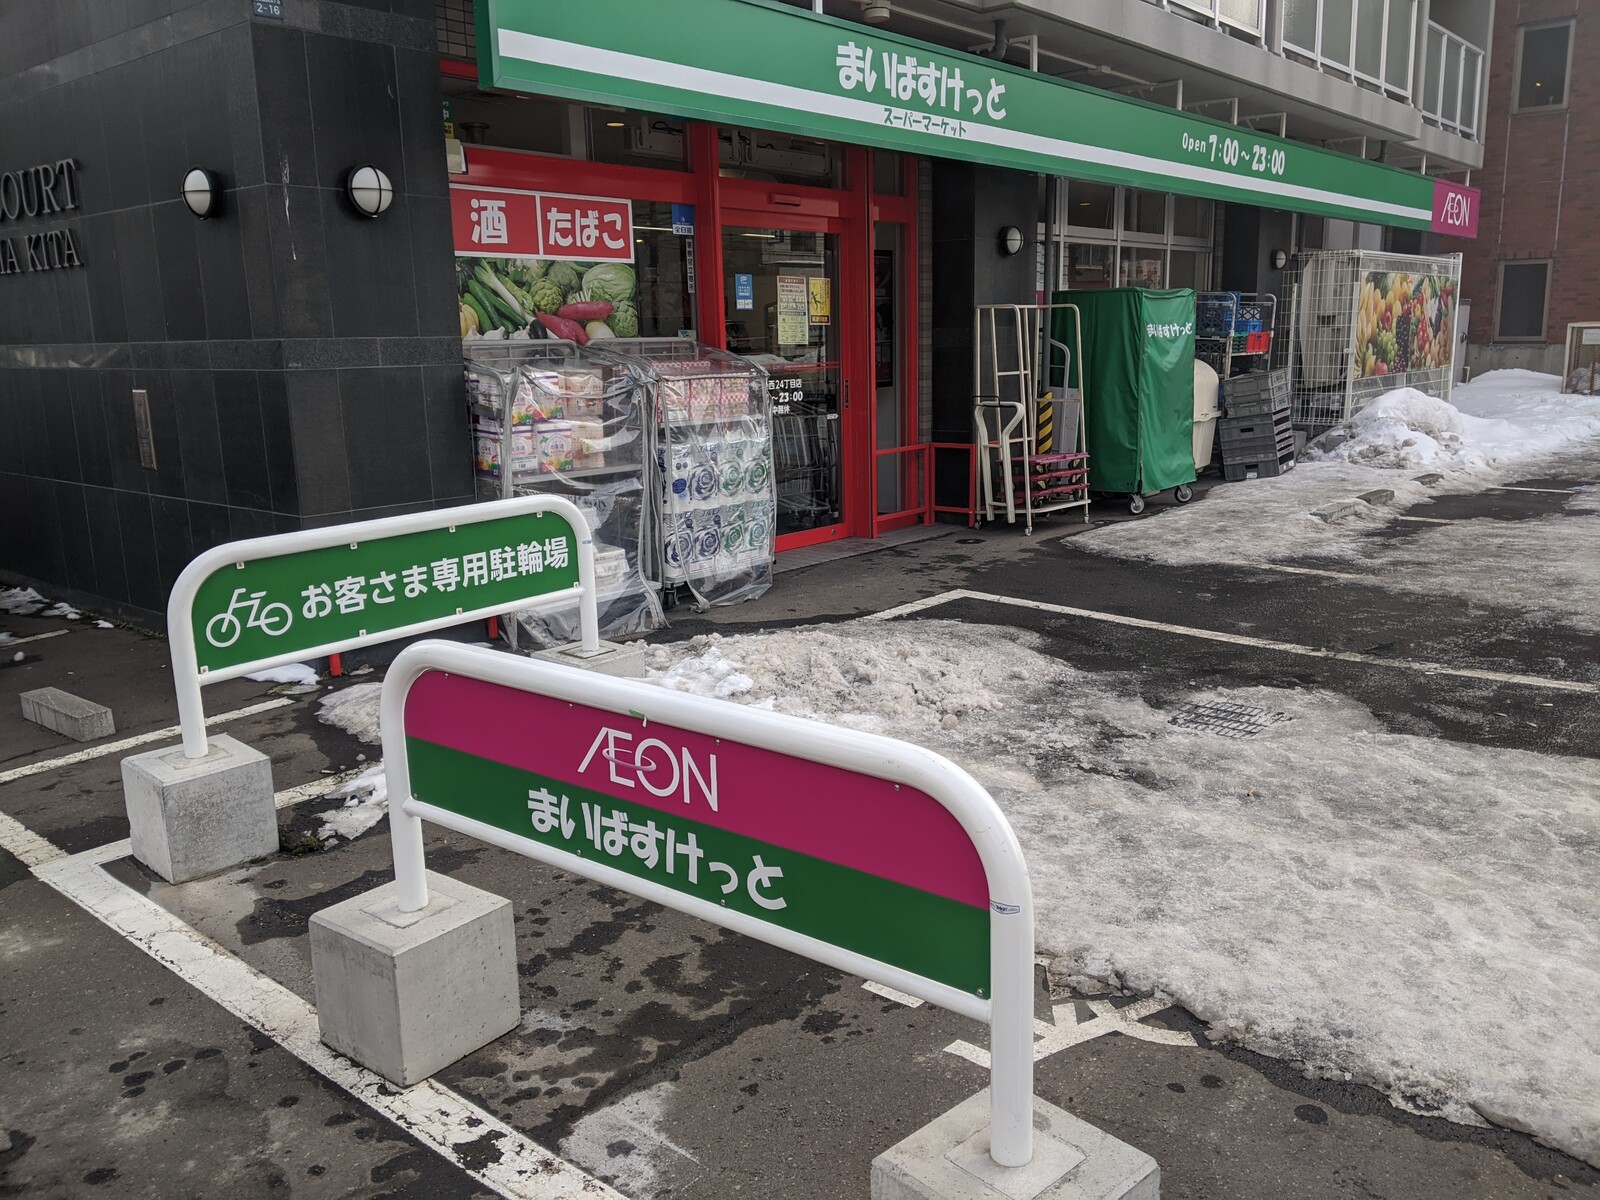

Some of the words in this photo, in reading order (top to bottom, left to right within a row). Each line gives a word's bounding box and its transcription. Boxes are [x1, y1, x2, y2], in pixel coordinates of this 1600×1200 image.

[256, 2, 280, 15] 2-16
[836, 41, 1007, 120] まいばすけっと
[884, 108, 966, 138] スーパーマーケット
[1182, 132, 1206, 153] Open
[0, 158, 76, 219] OURT
[470, 198, 508, 245] 酒
[546, 206, 625, 249] たばこ
[24, 228, 80, 271] KITA
[1147, 321, 1193, 338] まいばすけっと
[301, 536, 569, 619] お客さま専用駐輪場
[526, 787, 789, 911] まいばすけっと
